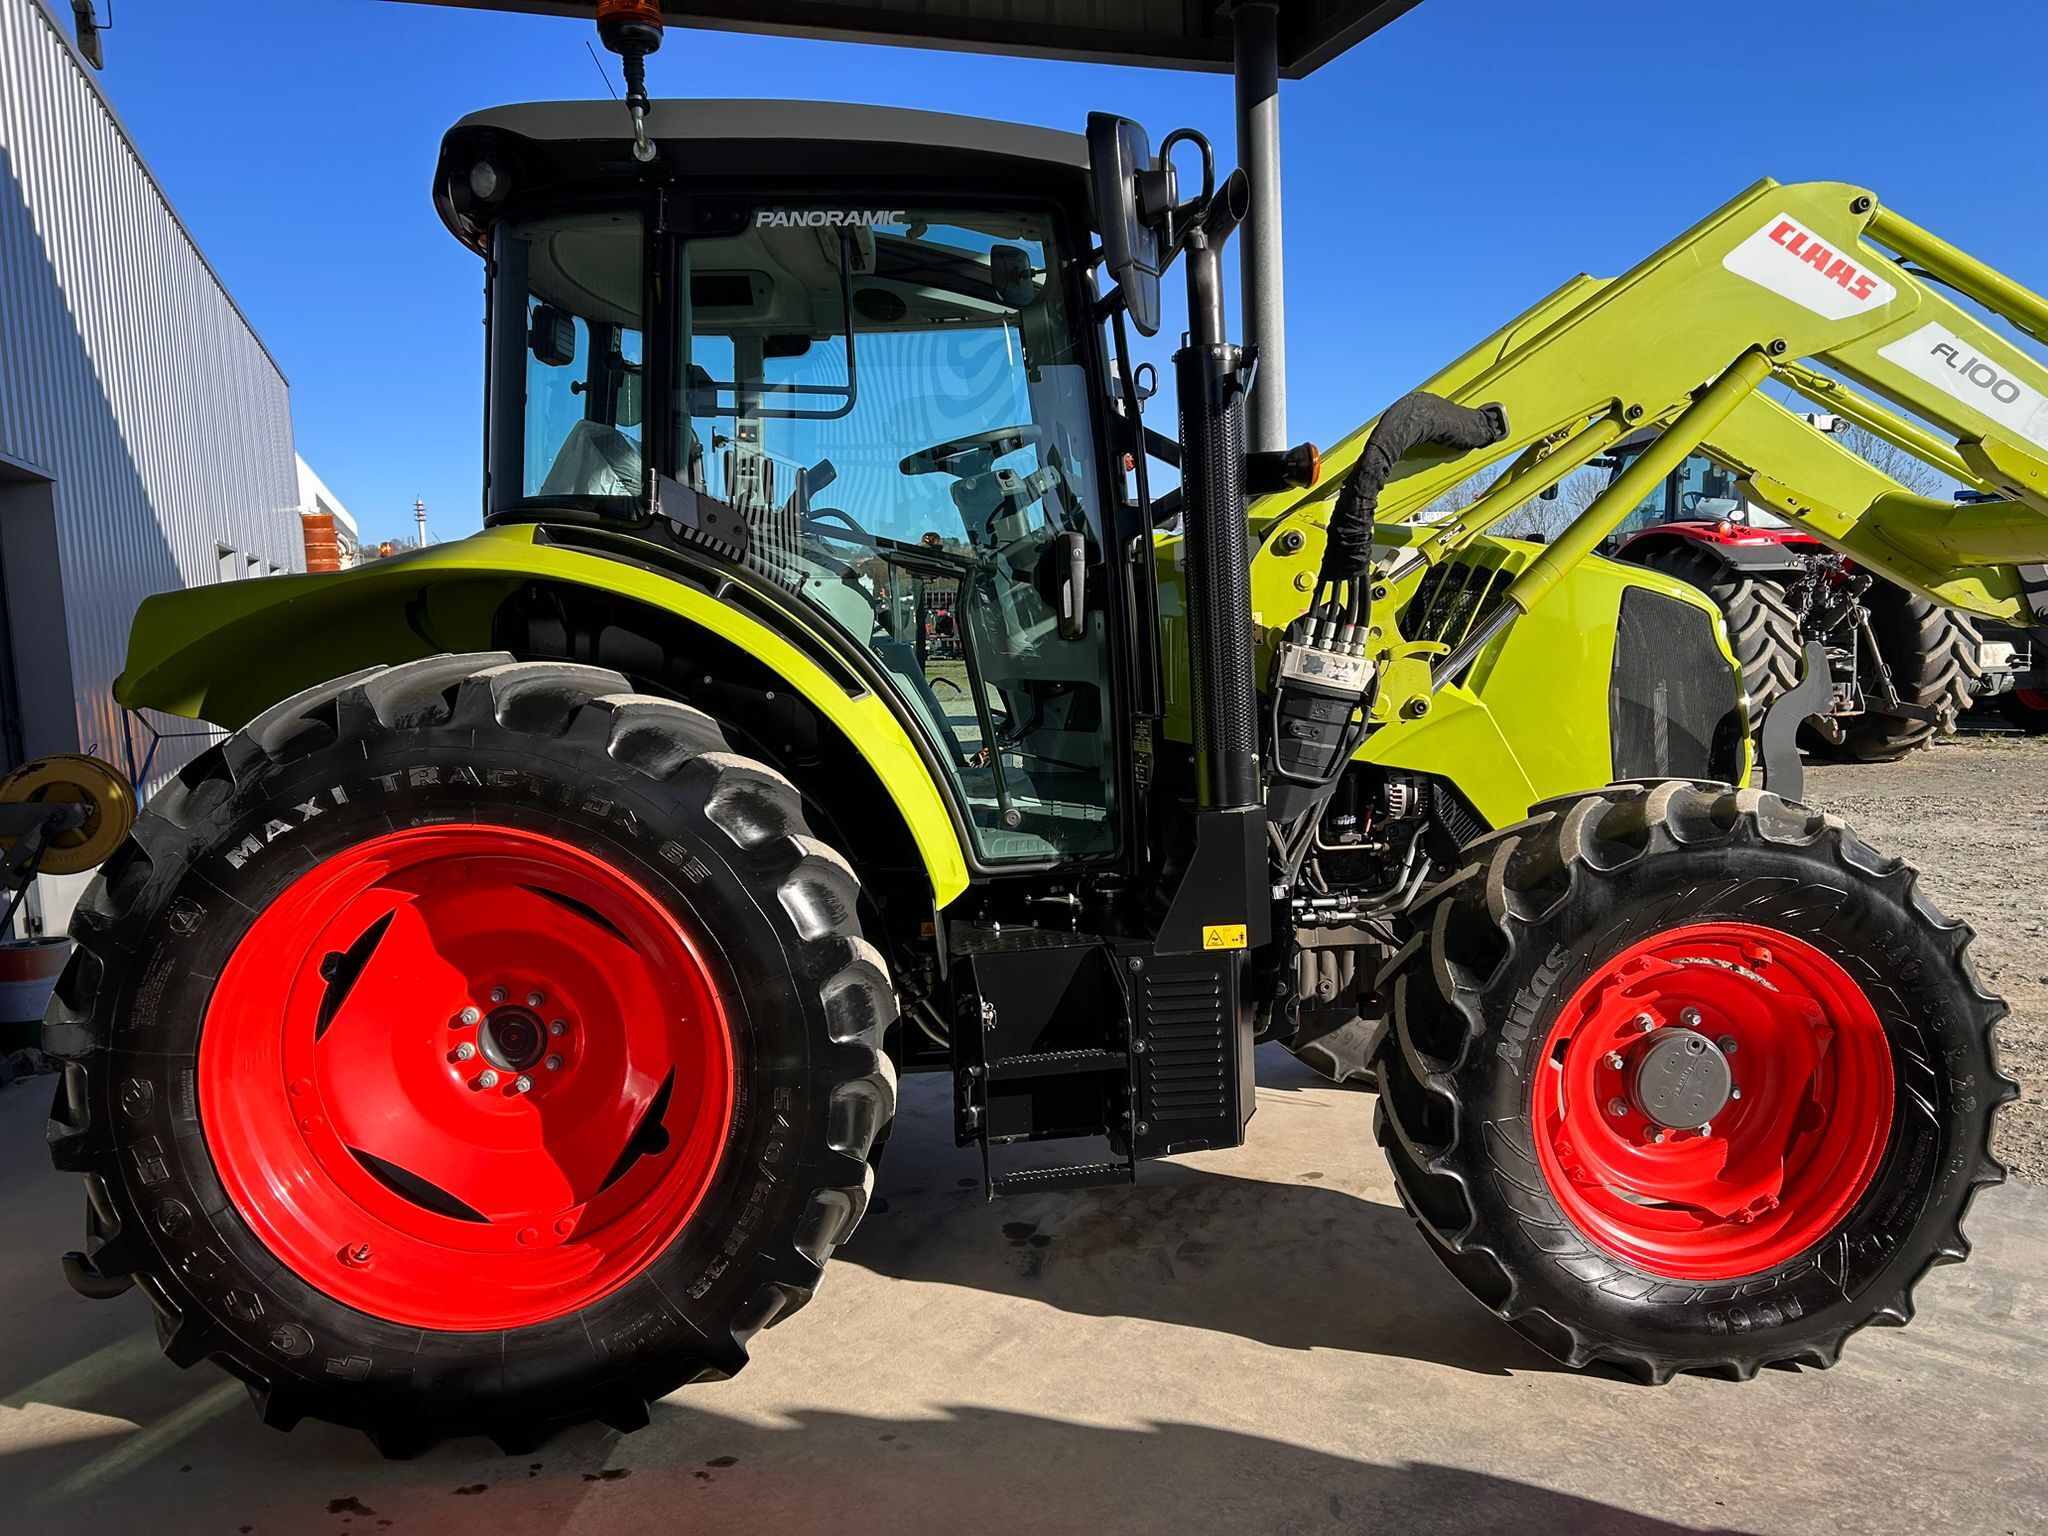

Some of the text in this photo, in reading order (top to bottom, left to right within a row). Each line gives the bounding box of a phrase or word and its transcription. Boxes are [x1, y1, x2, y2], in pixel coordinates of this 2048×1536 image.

[755, 210, 905, 229] PANORAMIC
[1768, 220, 1878, 301] CLAAS
[224, 765, 713, 885] MAXI TRACTION 65
[1496, 942, 1572, 1077] Mitas
